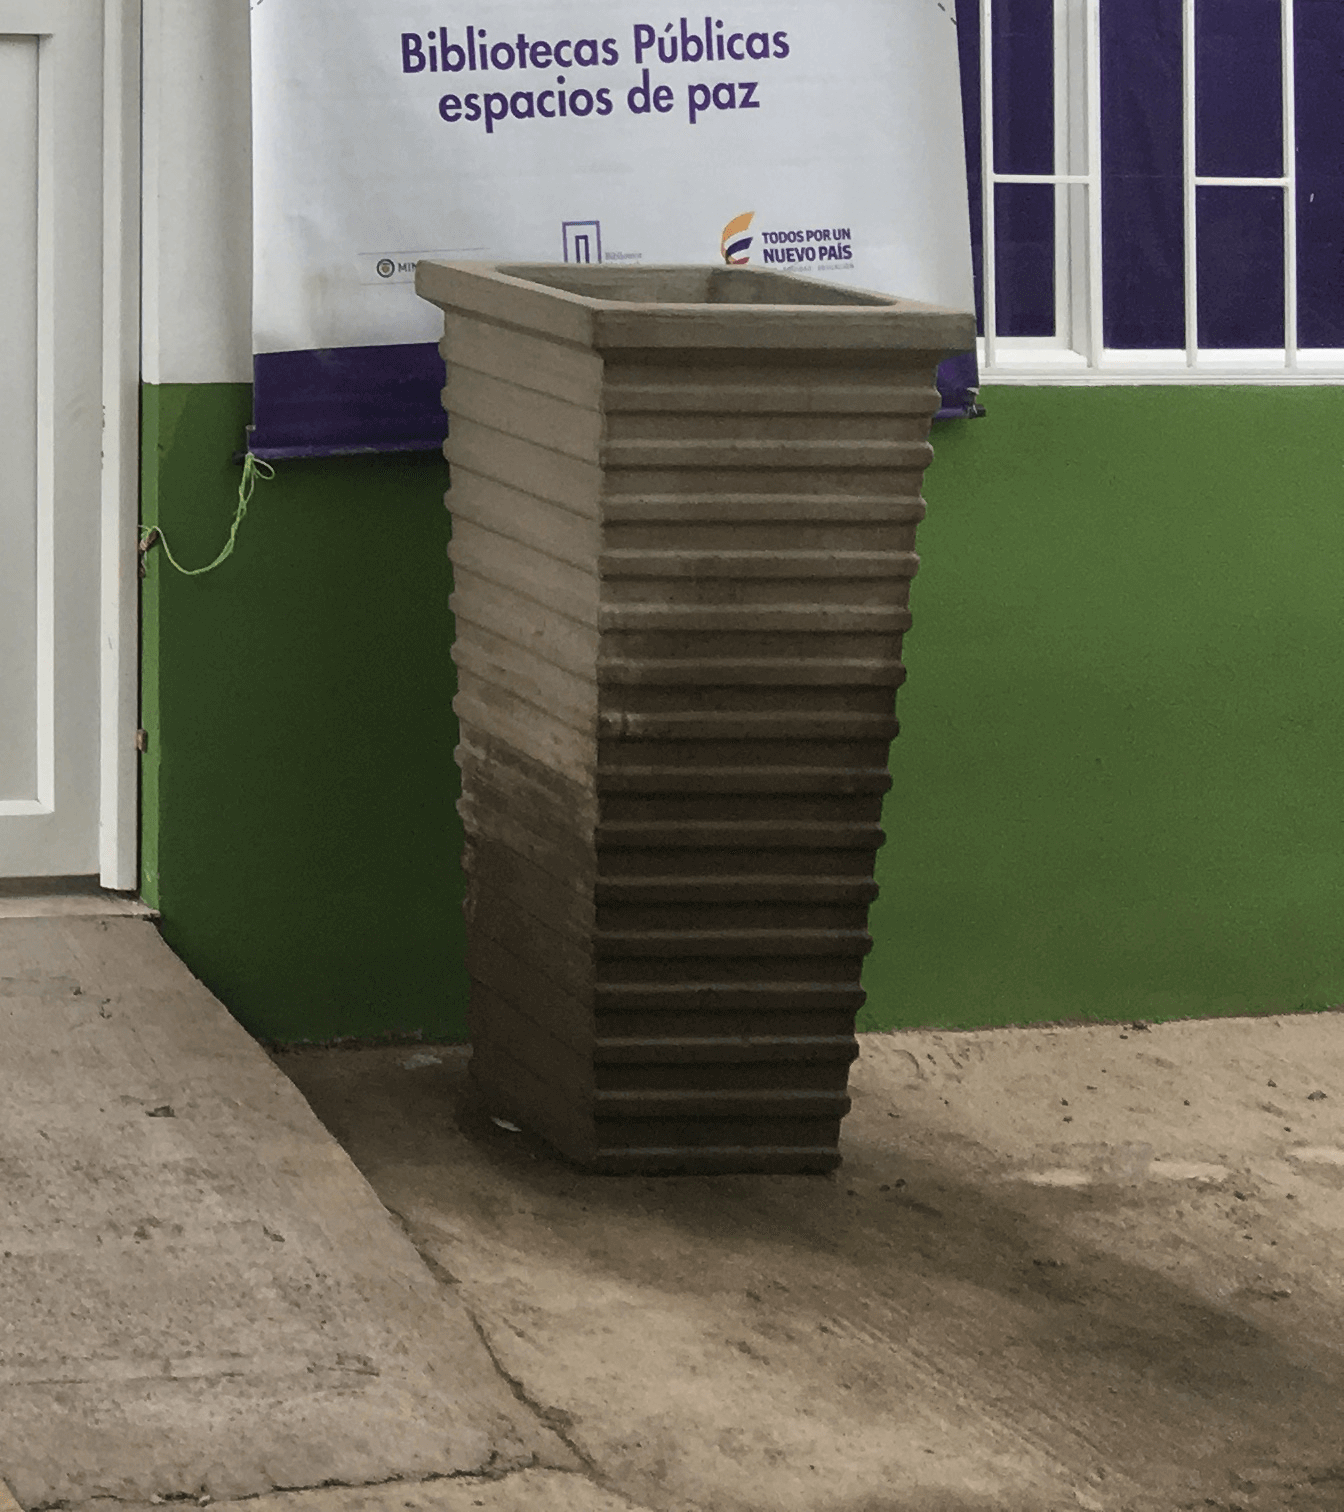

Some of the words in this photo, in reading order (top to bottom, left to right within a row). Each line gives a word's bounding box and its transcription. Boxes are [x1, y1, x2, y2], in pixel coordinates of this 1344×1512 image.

[401, 25, 619, 73] Bibliotecas
[634, 17, 790, 64] Públicas
[438, 75, 612, 133] espacios
[627, 68, 674, 114] de
[688, 81, 760, 124] paz
[762, 230, 804, 244] TODOS
[805, 229, 831, 242] POR
[832, 228, 851, 240] UN
[763, 246, 816, 263] NUEVO
[819, 243, 853, 261] PAÍS
